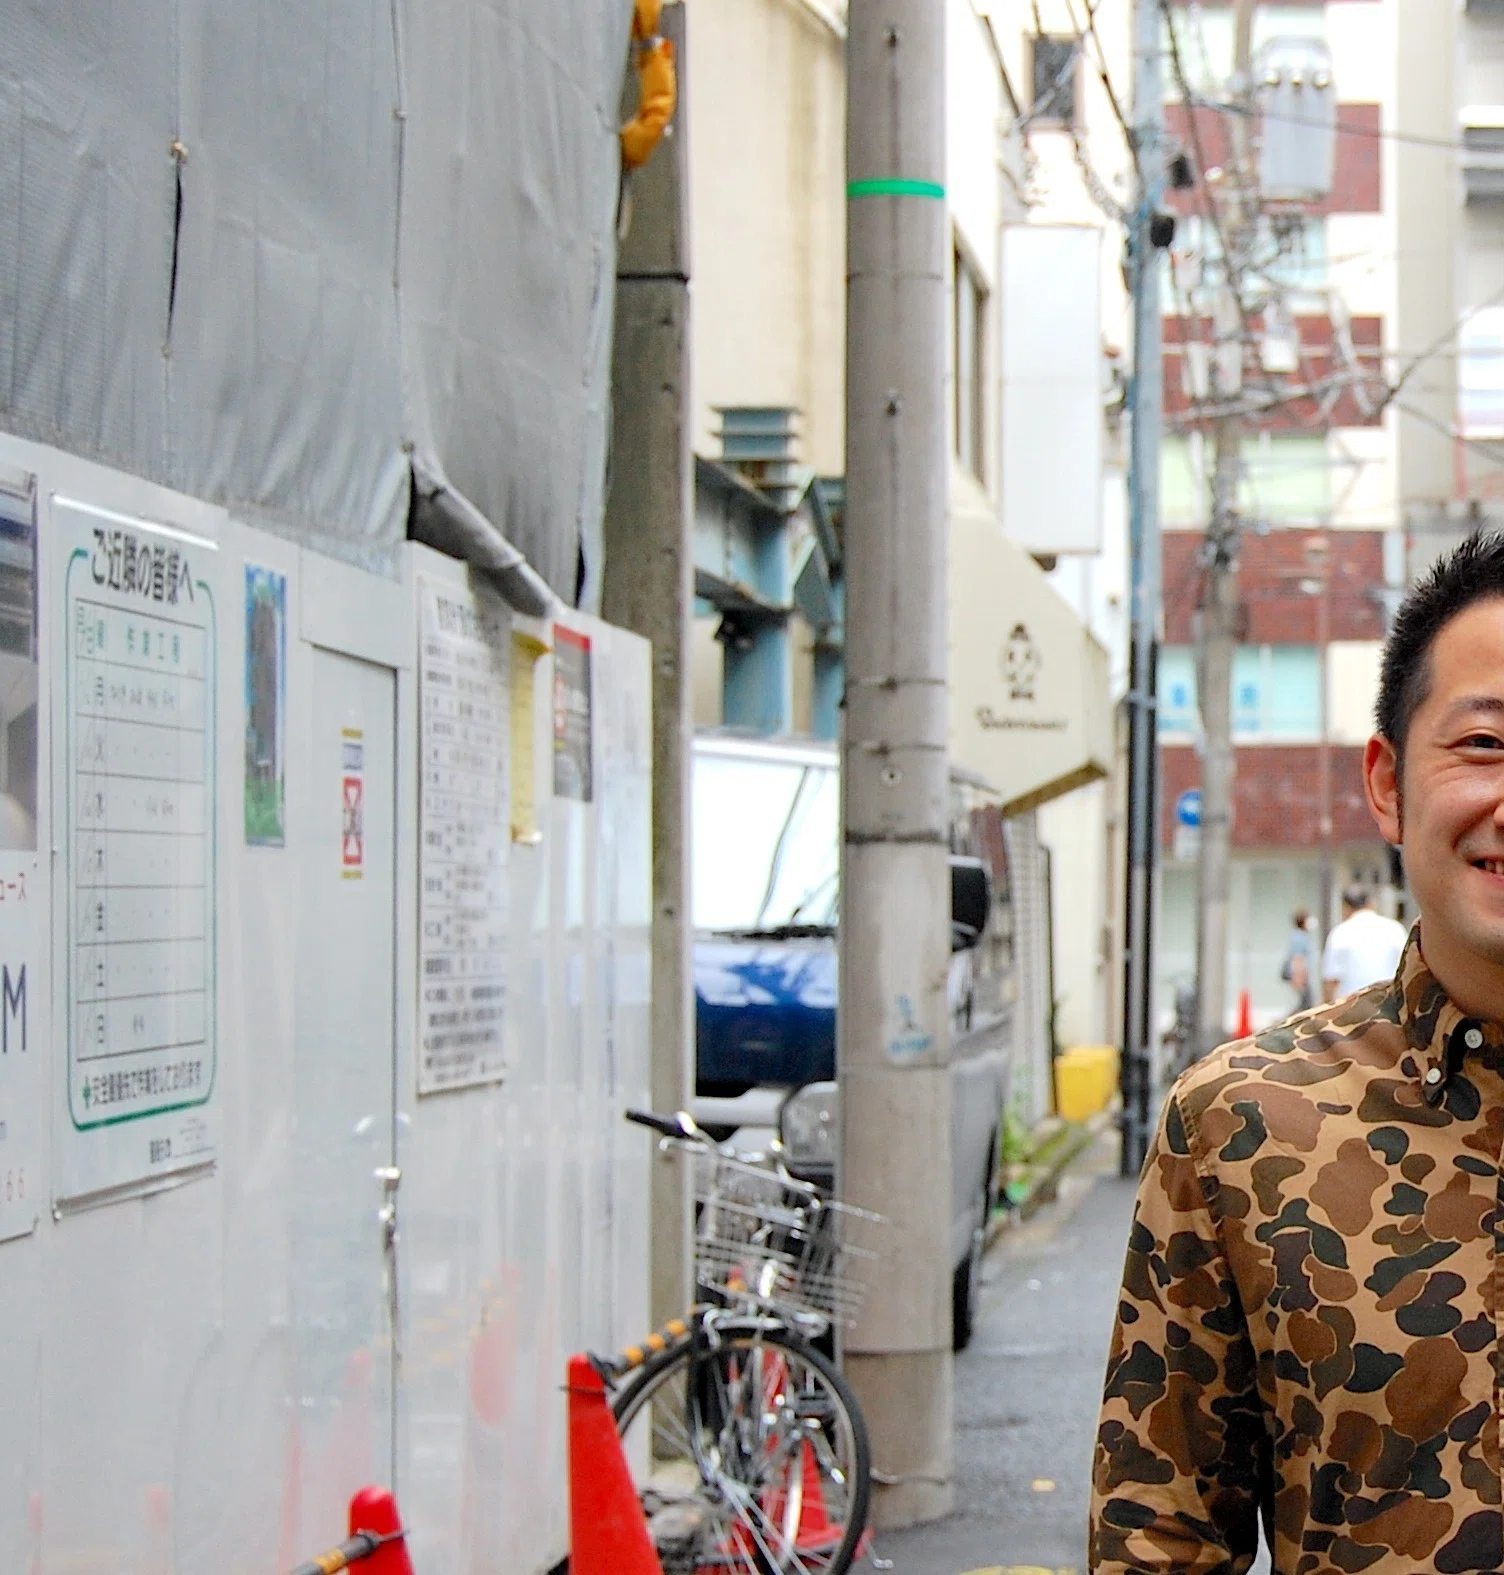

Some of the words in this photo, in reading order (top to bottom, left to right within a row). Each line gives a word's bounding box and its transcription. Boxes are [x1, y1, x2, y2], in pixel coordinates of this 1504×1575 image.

[91, 528, 194, 605] ご近隣の皆様へ
